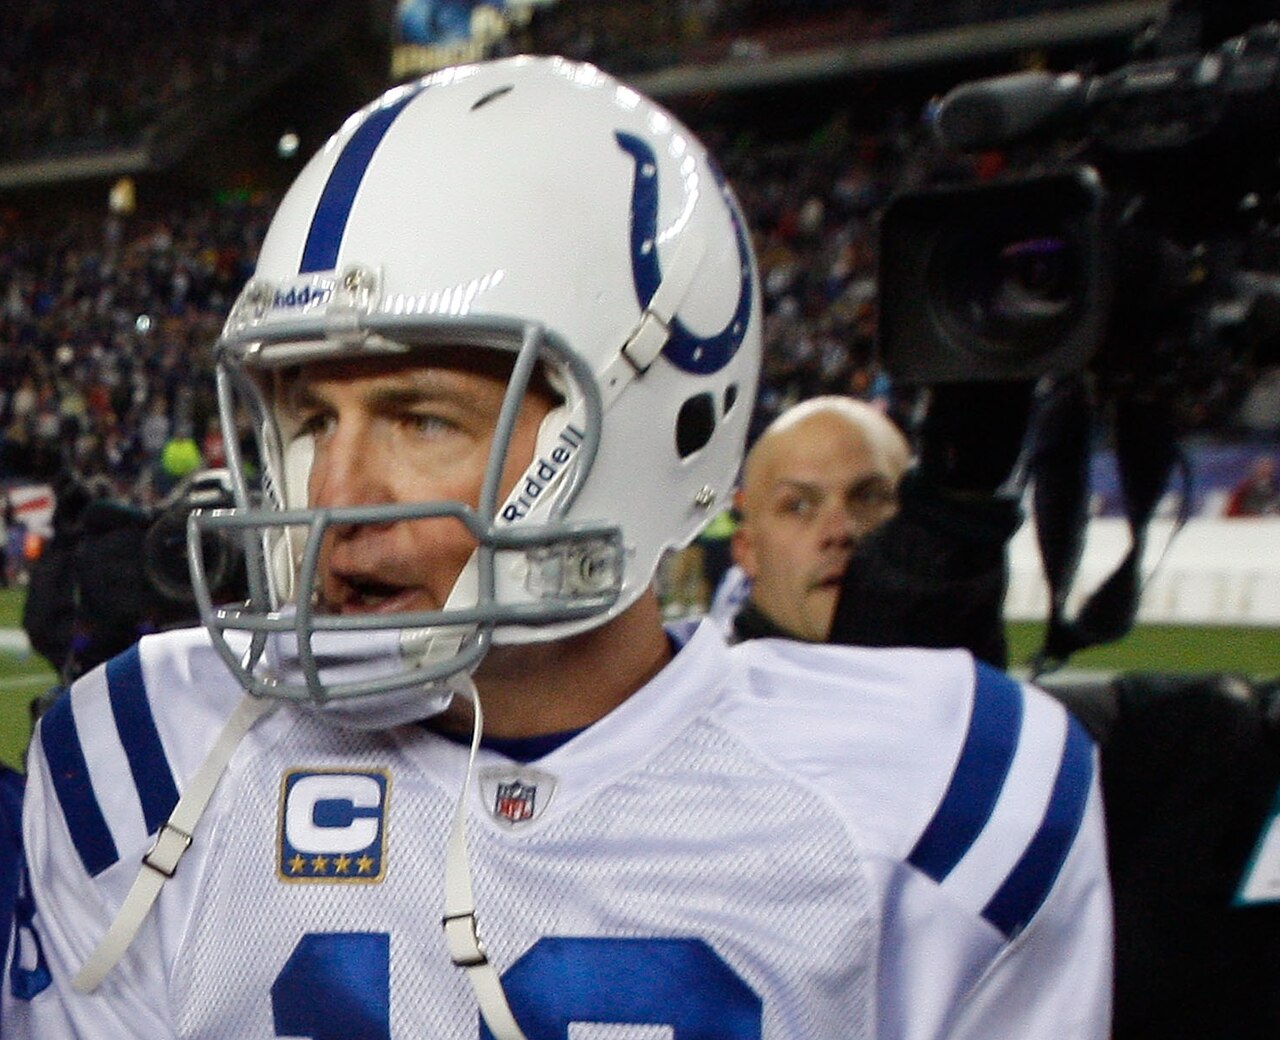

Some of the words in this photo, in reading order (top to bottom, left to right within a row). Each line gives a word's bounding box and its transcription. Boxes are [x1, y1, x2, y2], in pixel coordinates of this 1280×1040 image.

[502, 424, 584, 523] Riddell
[285, 774, 381, 854] C
[499, 798, 532, 821] NFL
